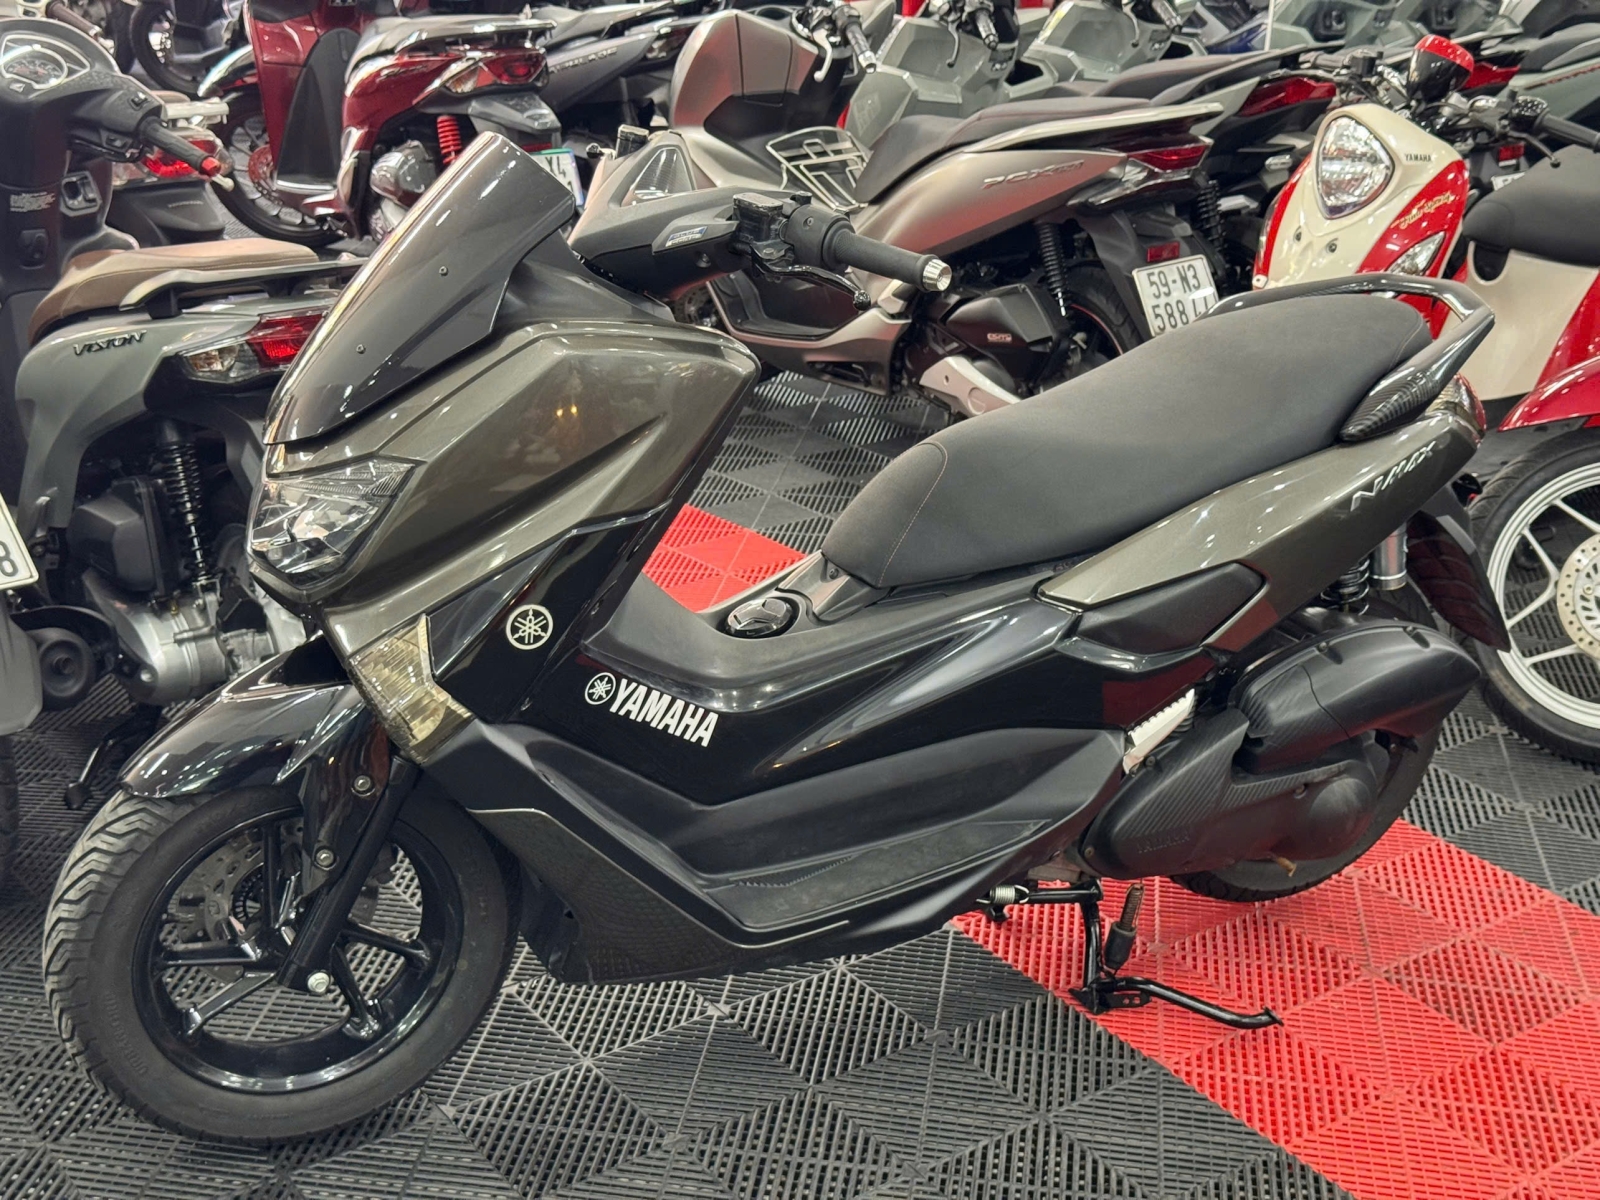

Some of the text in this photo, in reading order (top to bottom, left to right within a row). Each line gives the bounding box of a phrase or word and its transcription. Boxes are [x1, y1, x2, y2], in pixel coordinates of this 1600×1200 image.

[1404, 153, 1432, 162] YAMAHA
[1146, 263, 1201, 300] 59-N3
[73, 329, 148, 356] VISION
[609, 678, 719, 747] YAMAHA
